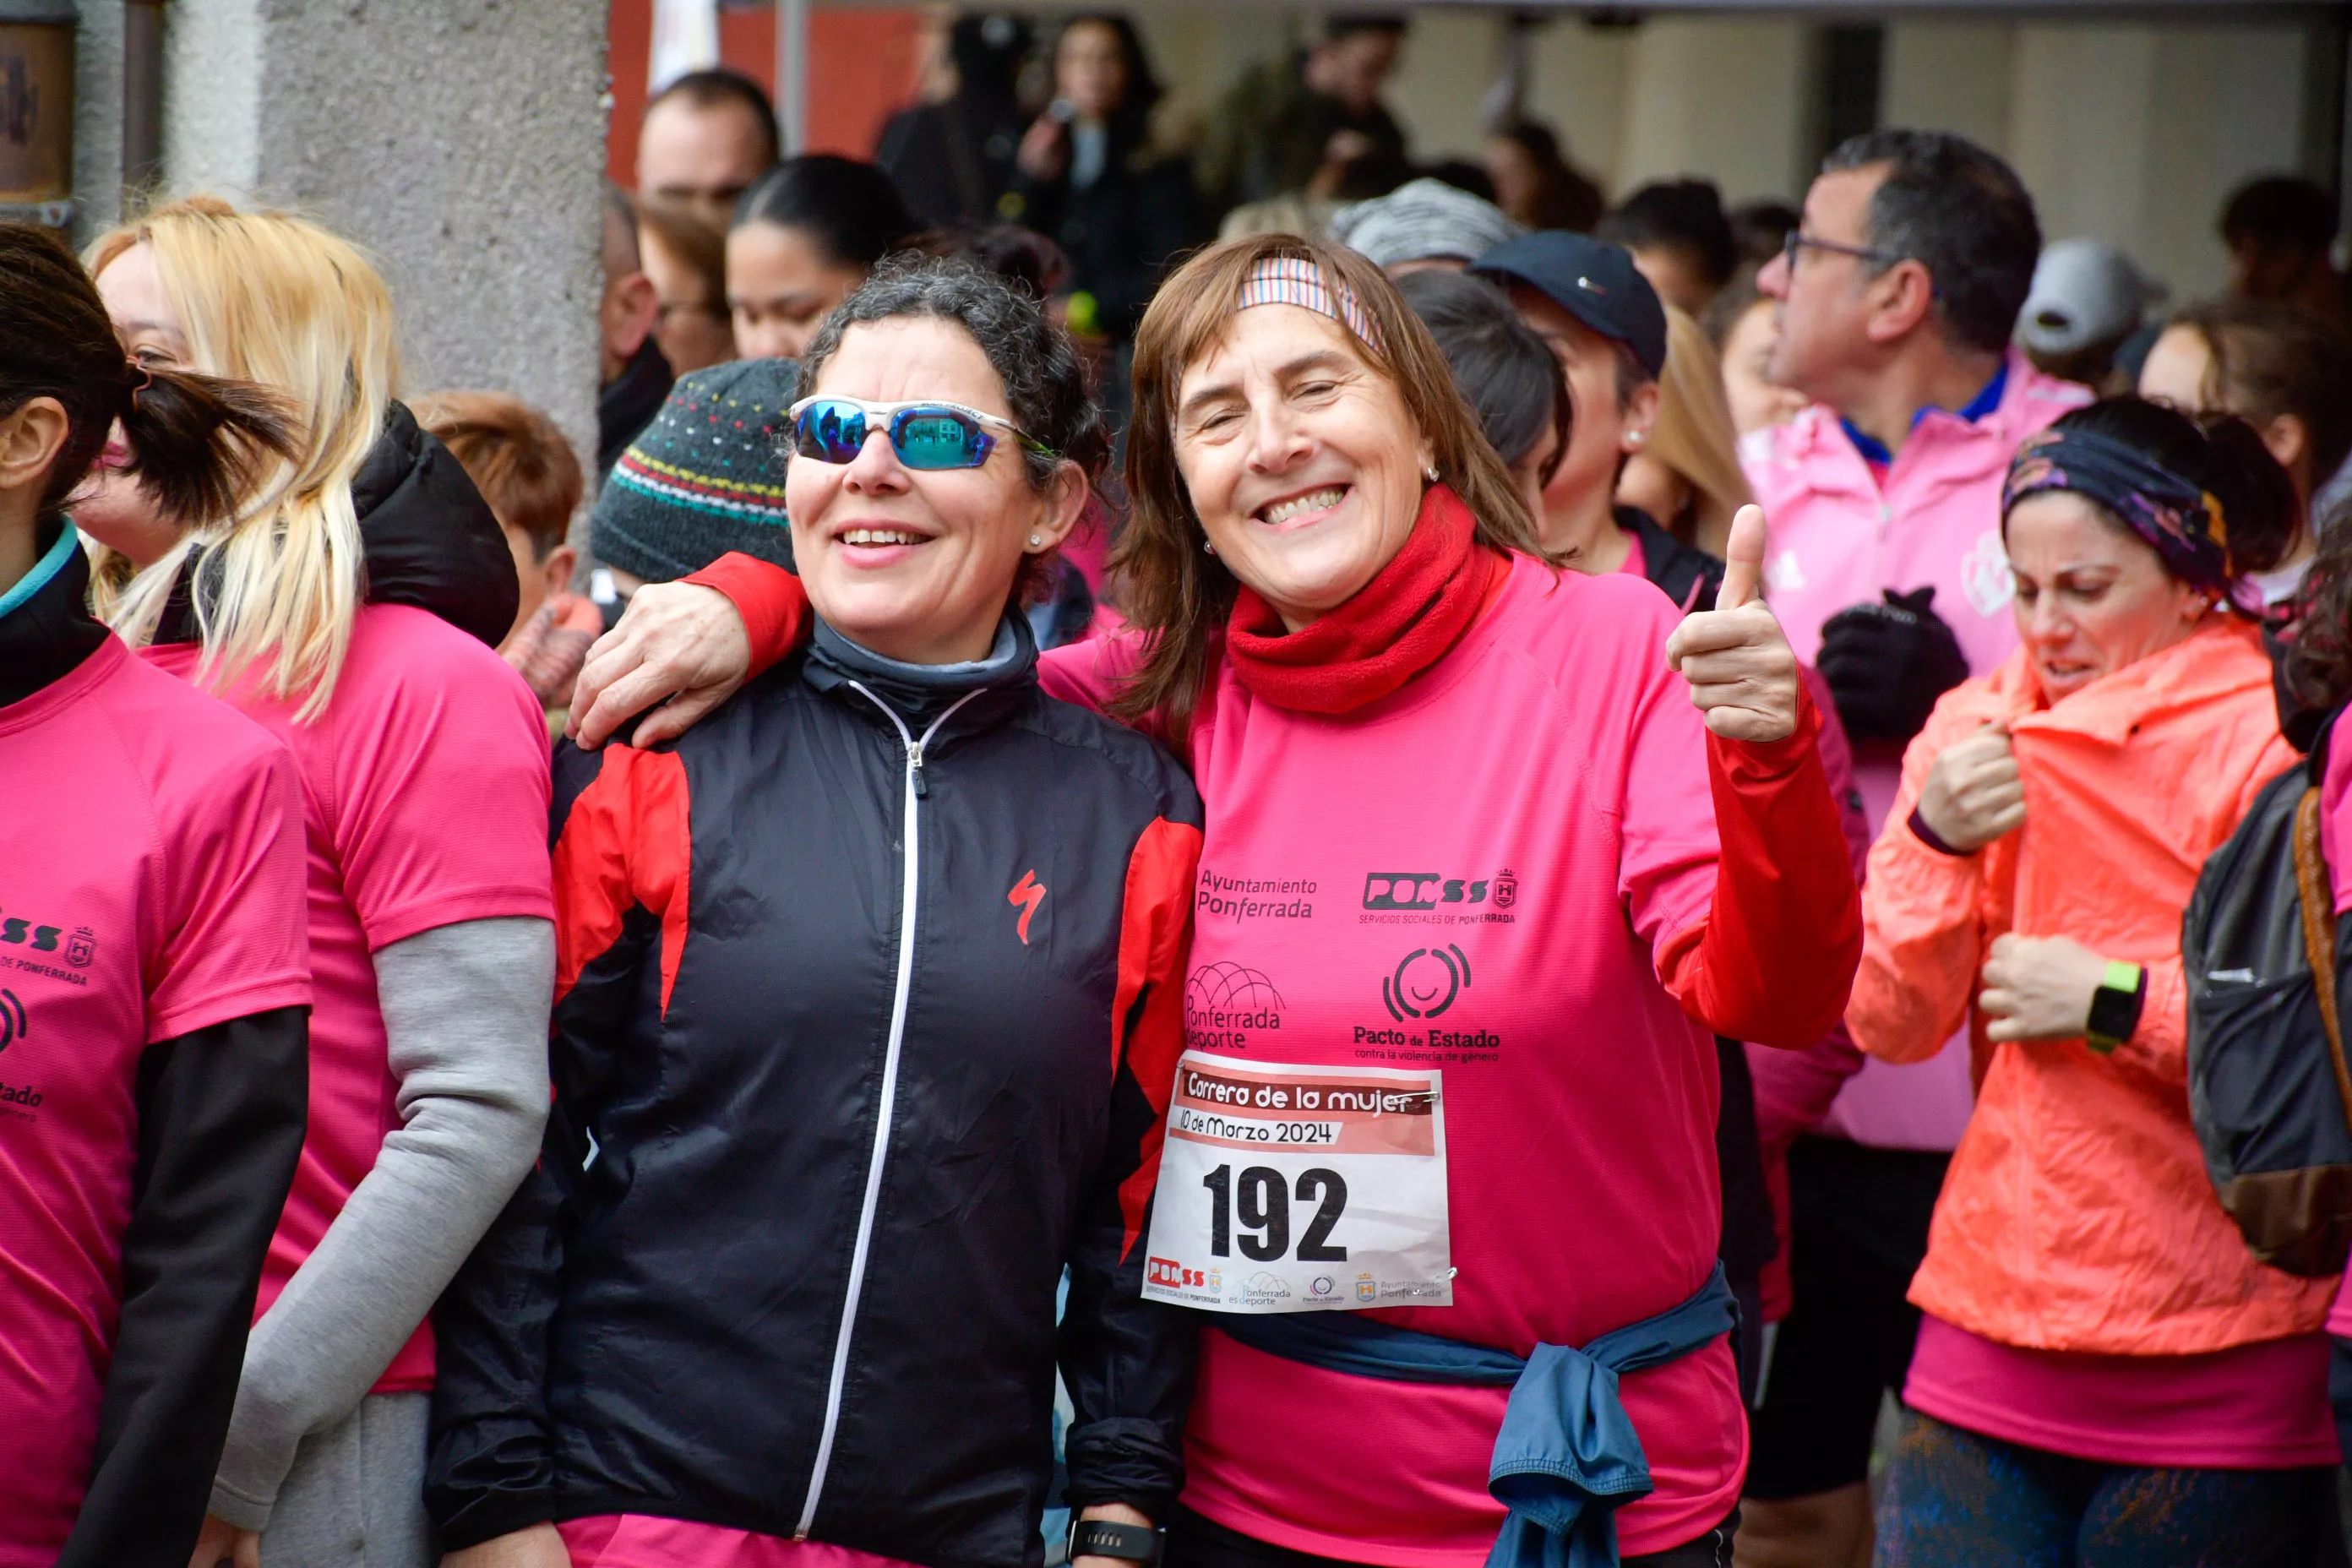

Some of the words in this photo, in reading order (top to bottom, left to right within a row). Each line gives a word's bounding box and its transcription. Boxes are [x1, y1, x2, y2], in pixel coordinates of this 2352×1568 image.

[1200, 869, 1317, 893] Ayuntamiento
[1198, 891, 1312, 924] Ponferrada
[1359, 914, 1400, 924] SERVICIOS
[1402, 914, 1442, 924] SOCIALES
[1444, 915, 1456, 925] DE
[1459, 913, 1515, 924] PONFERRADA
[16, 960, 87, 987] PONFERRADA
[1187, 994, 1280, 1029] Ponferrada
[1353, 1026, 1406, 1046] Pacto
[1409, 1036, 1424, 1047] de
[1428, 1029, 1500, 1048] Estado
[1355, 1049, 1386, 1059] contra
[1387, 1049, 1395, 1059] la
[1399, 1050, 1442, 1062] violencia
[1446, 1051, 1458, 1062] de
[1188, 1072, 1250, 1106] Carrera
[1255, 1086, 1288, 1108] de
[1296, 1086, 1320, 1109] la
[1327, 1089, 1413, 1119] mujer
[1180, 1109, 1190, 1130] 10
[1191, 1114, 1204, 1132] de
[1206, 1117, 1269, 1141] Marzo
[1277, 1123, 1331, 1142] 2024
[1203, 1163, 1348, 1262] 192
[1190, 1294, 1222, 1304] PONFERRADA
[1239, 1294, 1277, 1306] deporte
[1242, 1284, 1291, 1298] Ponferrada
